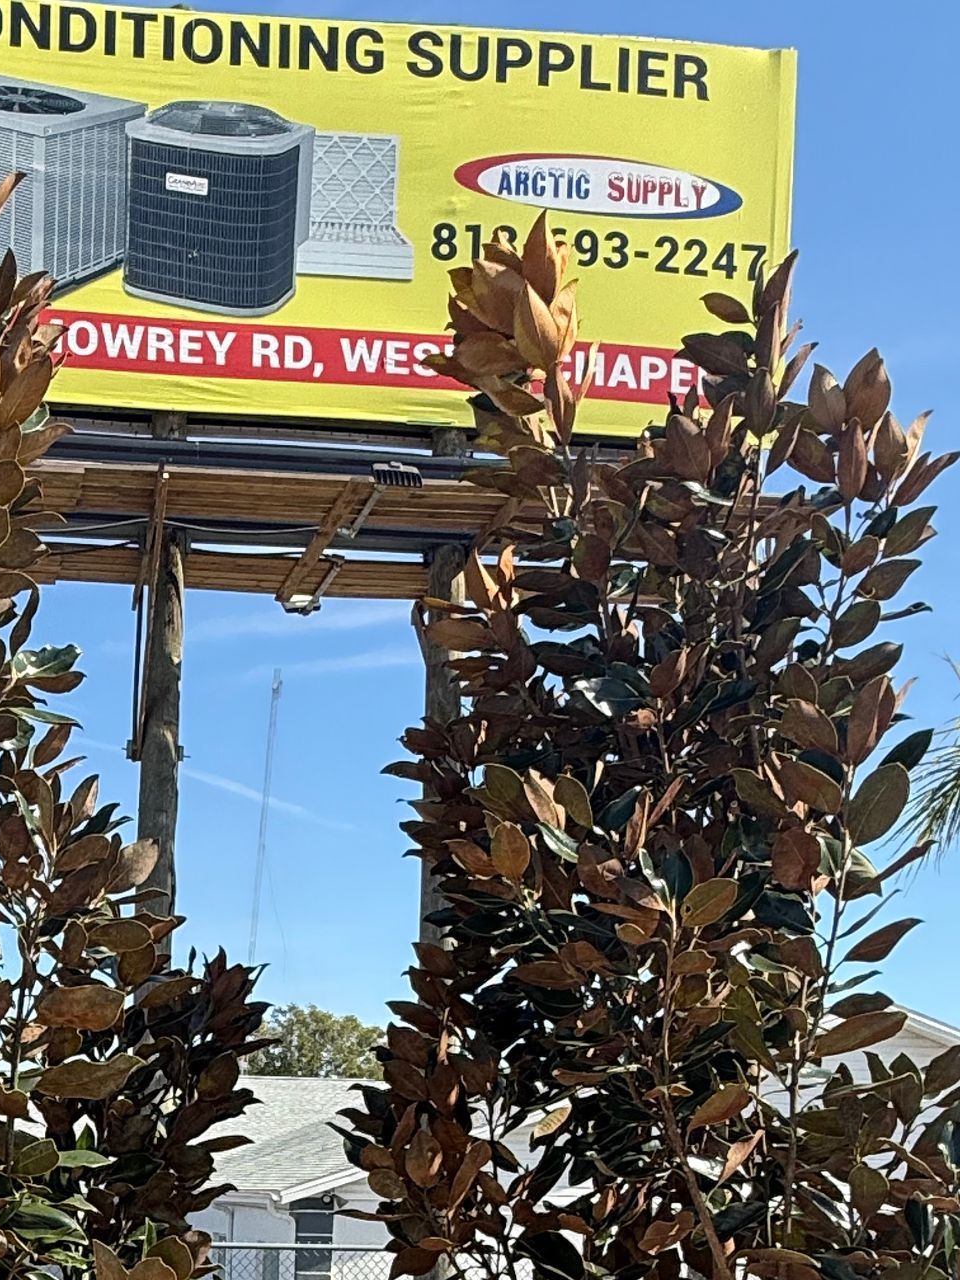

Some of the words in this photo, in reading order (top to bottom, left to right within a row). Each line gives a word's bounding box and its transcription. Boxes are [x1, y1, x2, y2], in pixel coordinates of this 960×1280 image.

[406, 31, 710, 102] SUPPLIER
[497, 165, 590, 200] ARCTIC
[607, 171, 708, 211] SUPPLY
[251, 332, 324, 378] RD,
[561, 350, 707, 396] HAPE
